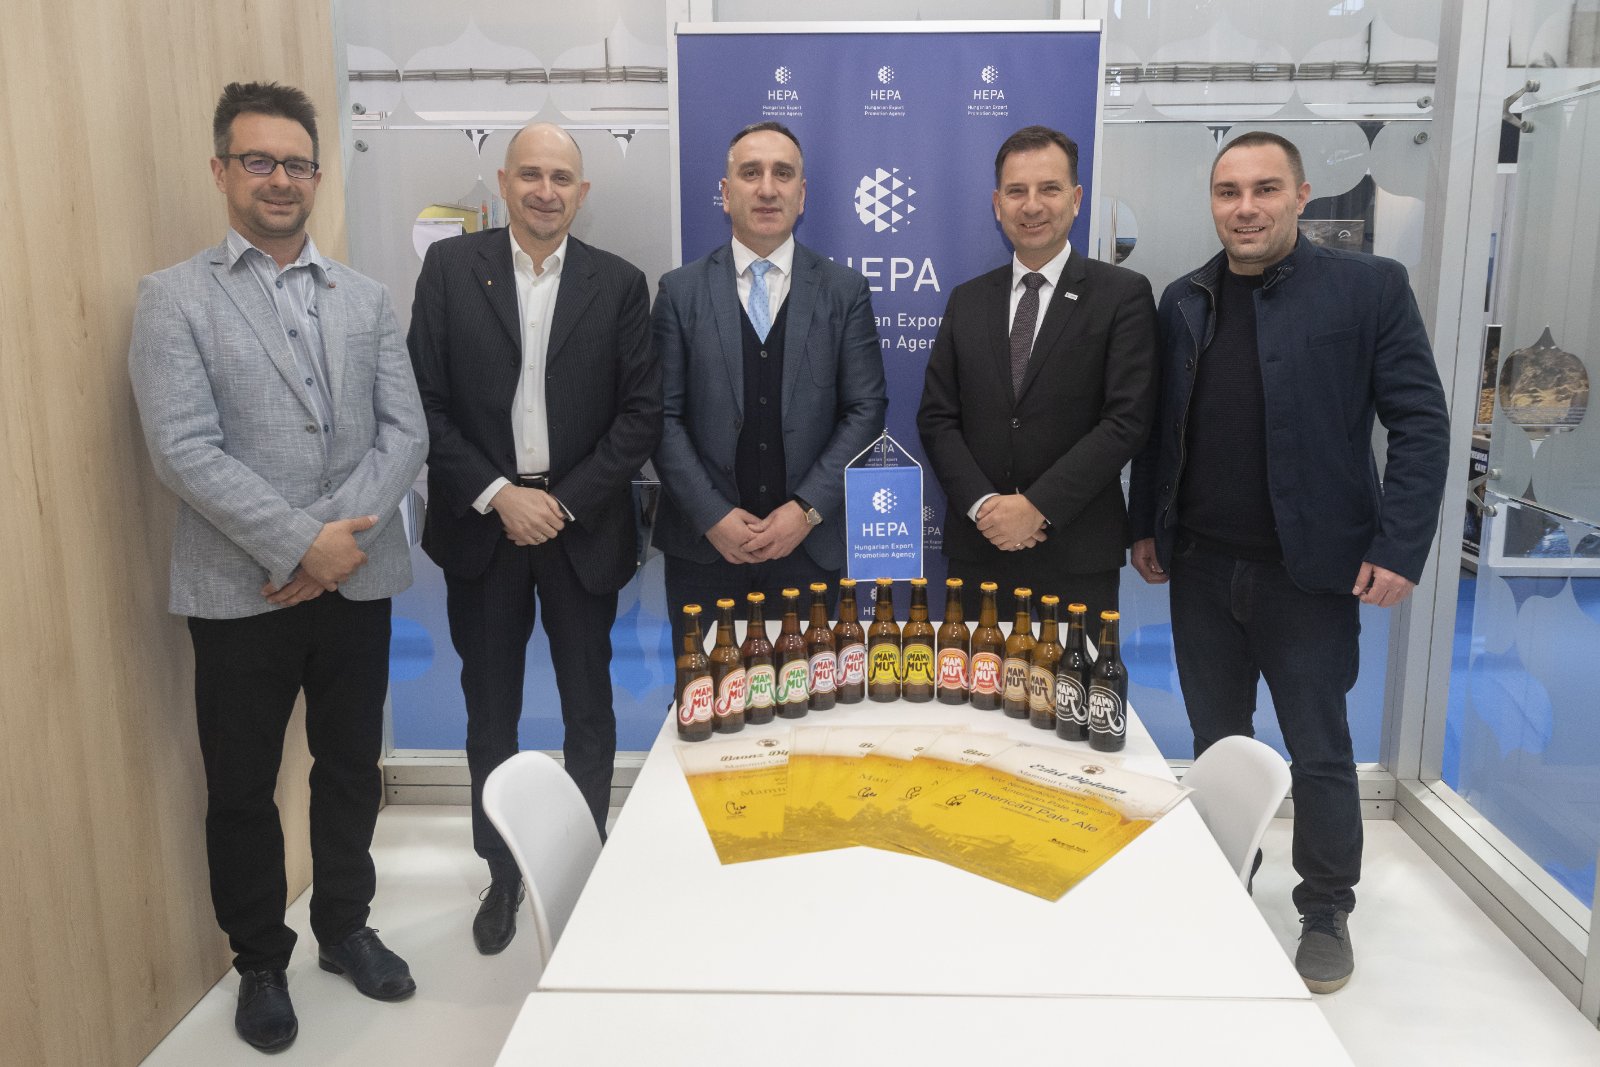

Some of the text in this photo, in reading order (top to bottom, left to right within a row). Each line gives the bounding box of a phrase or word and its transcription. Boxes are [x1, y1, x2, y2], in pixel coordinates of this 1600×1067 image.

[768, 90, 799, 100] HEPA
[870, 90, 901, 100] HEPA
[973, 90, 1005, 100] HEPA
[897, 312, 943, 331] Expor
[862, 521, 909, 537] HEPA
[923, 526, 942, 536] EPA
[891, 551, 916, 559] Agency
[863, 606, 876, 616] HE
[1007, 667, 1025, 677] MAM
[1067, 775, 1127, 794] Diploma
[968, 787, 1034, 812] American
[1036, 807, 1070, 823] Pale
[1071, 820, 1099, 833] Ale
